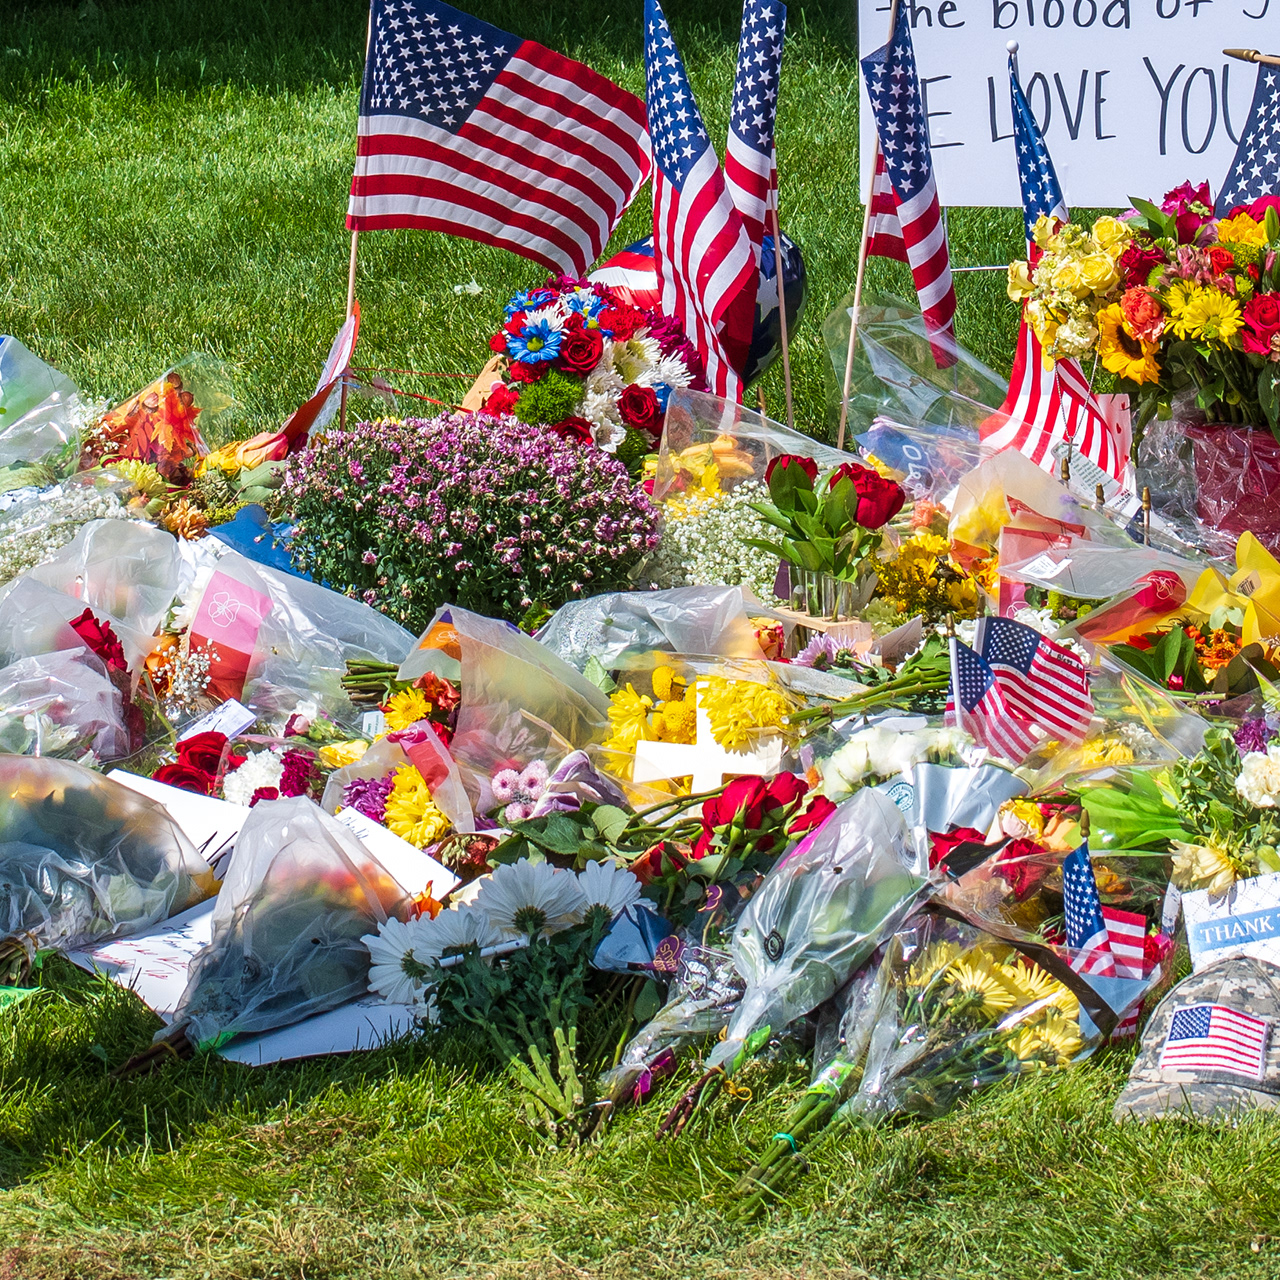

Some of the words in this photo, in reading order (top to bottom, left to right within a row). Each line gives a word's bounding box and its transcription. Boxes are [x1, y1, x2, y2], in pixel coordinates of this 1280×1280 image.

[920, 74, 965, 149] E
[987, 69, 1117, 143] LOVE
[1199, 914, 1275, 944] THANK
